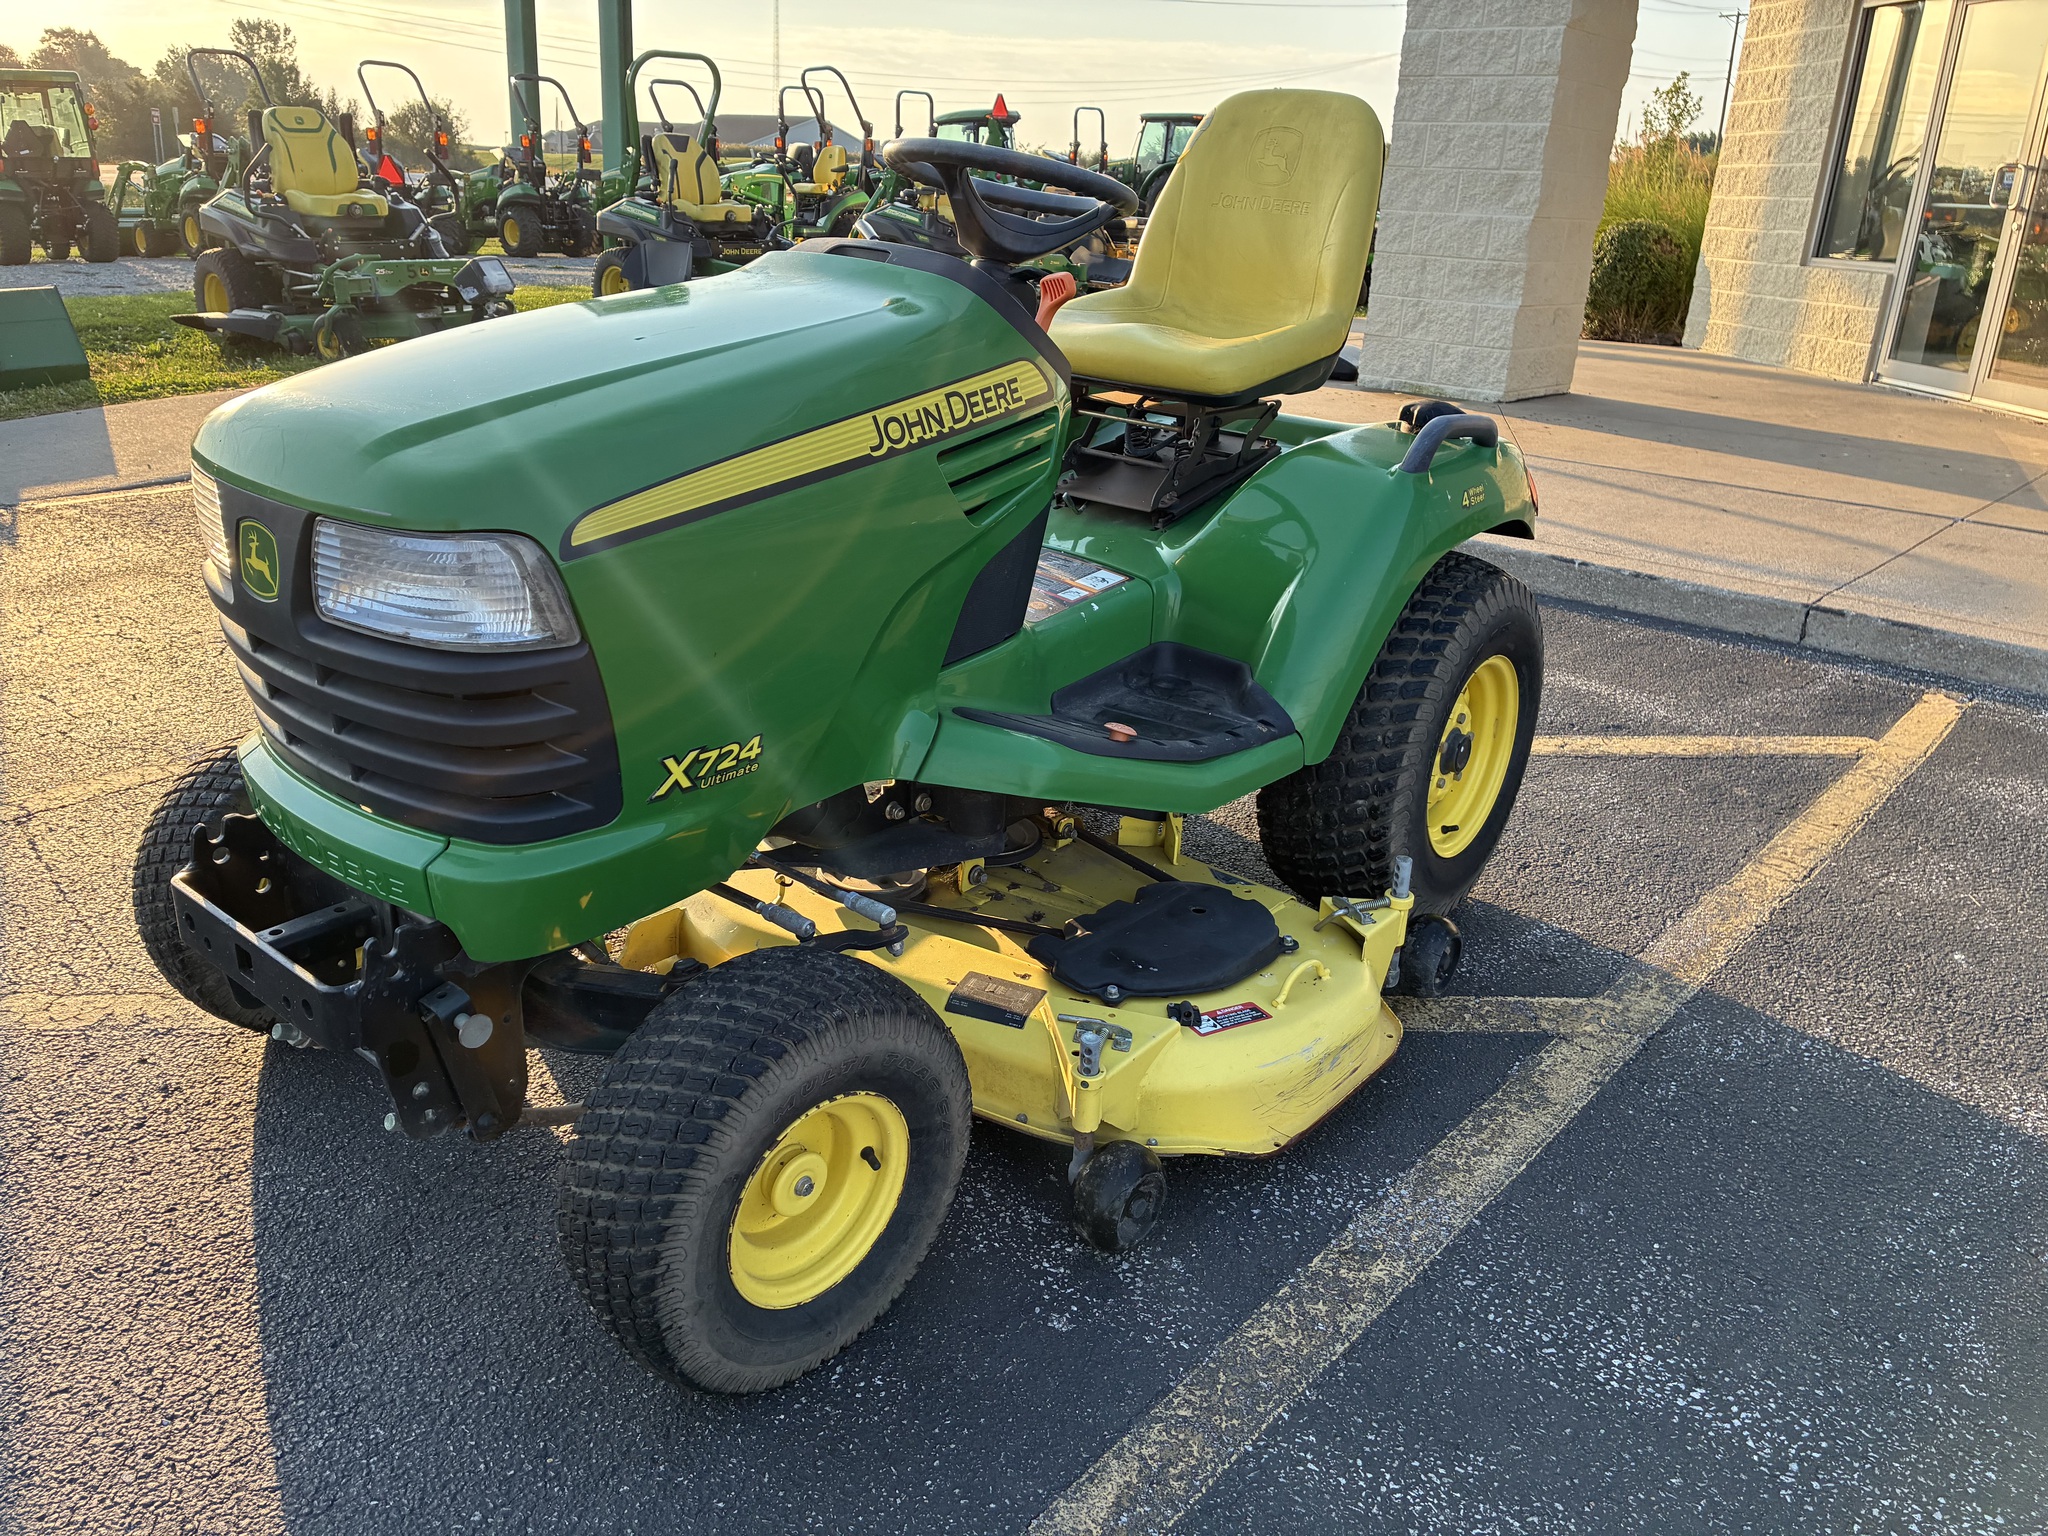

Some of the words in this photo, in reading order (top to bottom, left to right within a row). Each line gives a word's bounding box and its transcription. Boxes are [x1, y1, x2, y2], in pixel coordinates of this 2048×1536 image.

[1210, 192, 1257, 211] JOHN
[1258, 195, 1311, 216] DEERE
[721, 247, 740, 255] JOHN
[741, 247, 763, 255] DEERE
[868, 401, 948, 456] JOHN
[944, 376, 1026, 429] DEERE
[1462, 490, 1470, 508] 4
[648, 733, 763, 801] X724
[700, 762, 760, 790] Ultimate
[301, 828, 409, 904] DEERE
[772, 1054, 872, 1125] MULTI
[881, 1052, 942, 1092] TRAC
